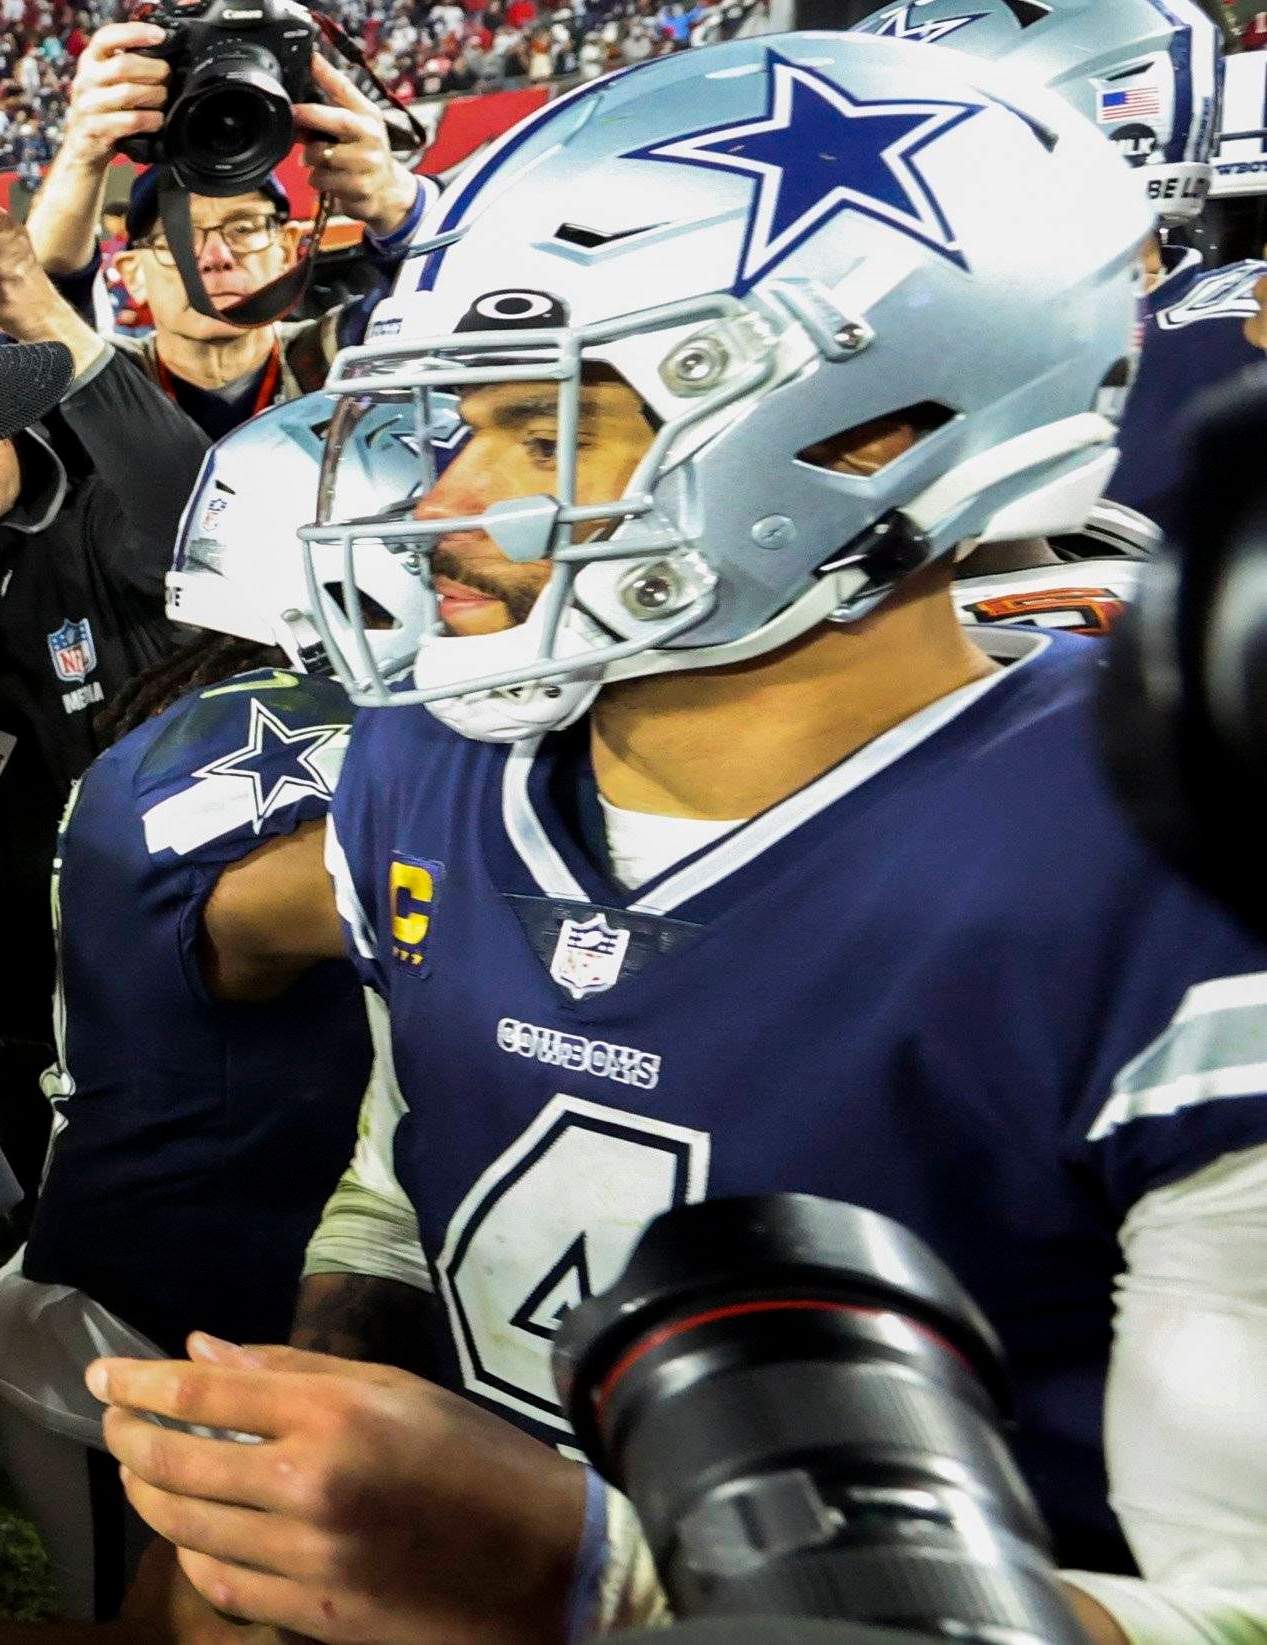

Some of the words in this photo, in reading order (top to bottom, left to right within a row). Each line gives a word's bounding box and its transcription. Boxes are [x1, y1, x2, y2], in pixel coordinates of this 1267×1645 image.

[1147, 179, 1179, 200] BE
[390, 861, 434, 945] C
[497, 1017, 662, 1090] COWBOYS
